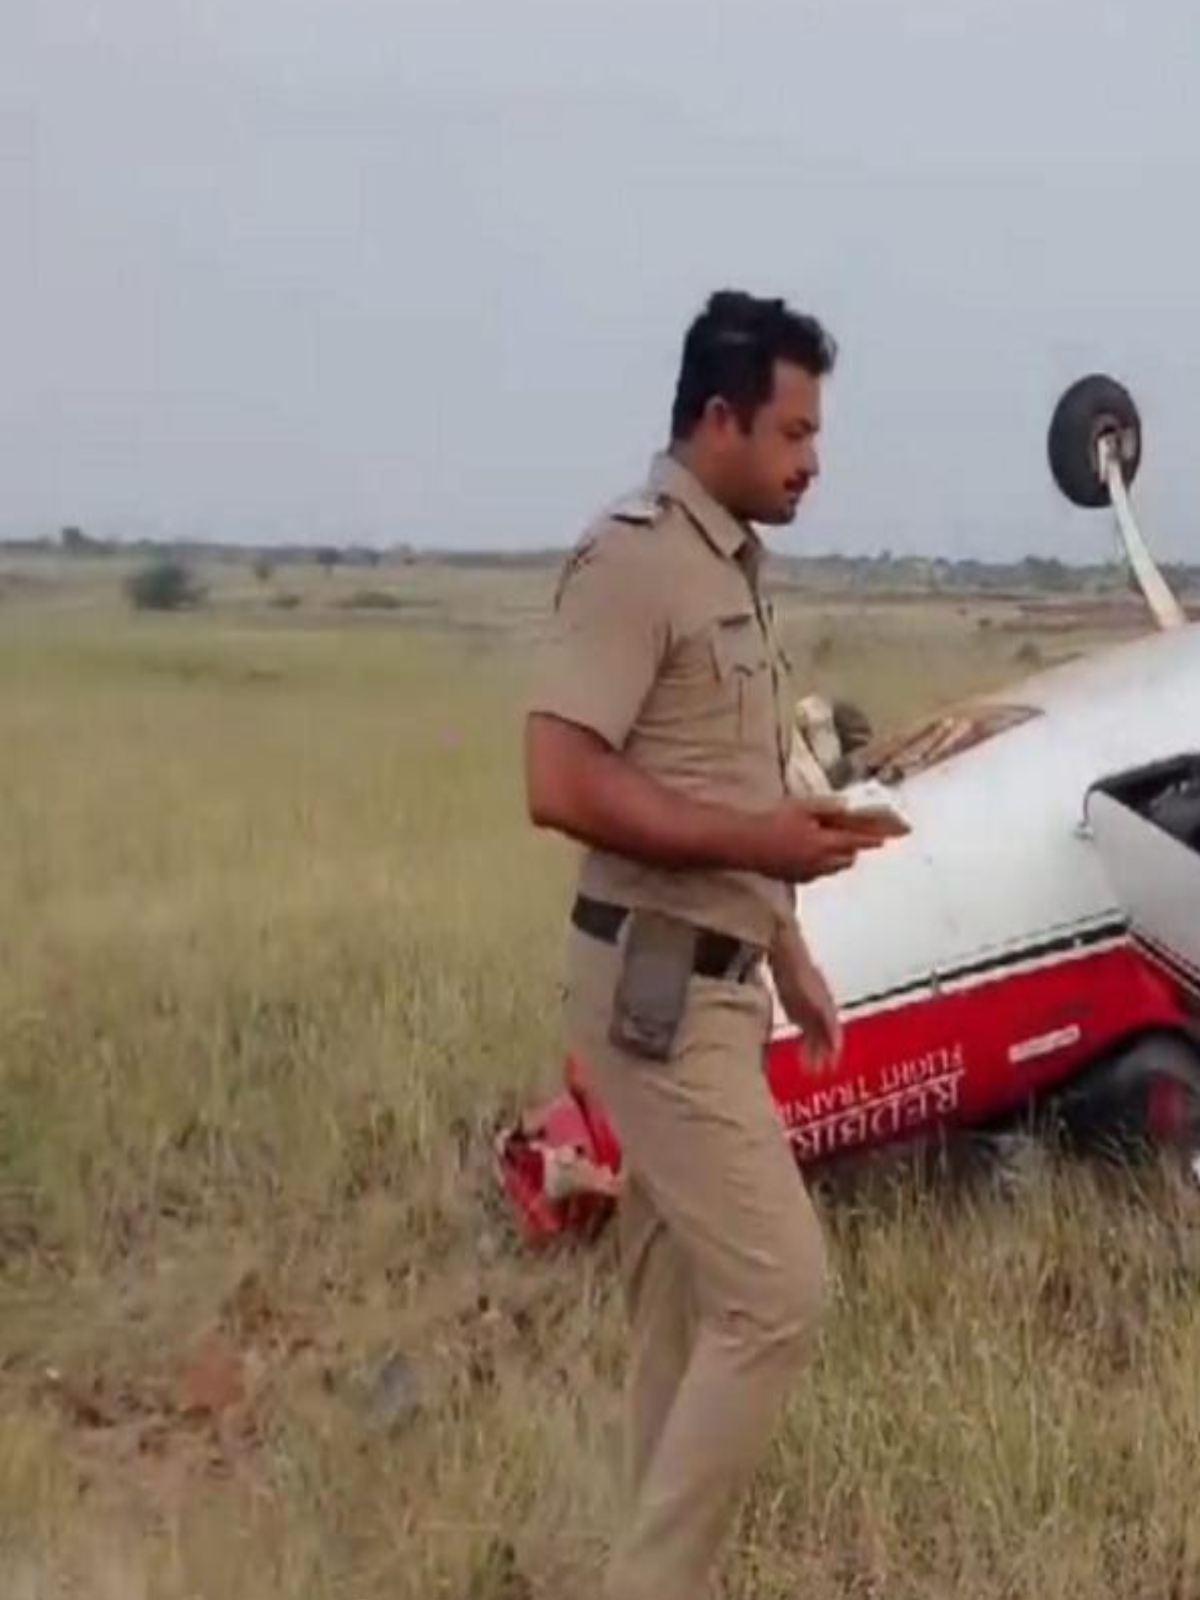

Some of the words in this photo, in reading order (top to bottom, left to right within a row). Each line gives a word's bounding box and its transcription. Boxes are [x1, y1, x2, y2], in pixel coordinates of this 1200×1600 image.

[880, 1044, 963, 1090] FLIGHT
[779, 1078, 868, 1124] TRAINI
[796, 1077, 960, 1157] REDBIR
